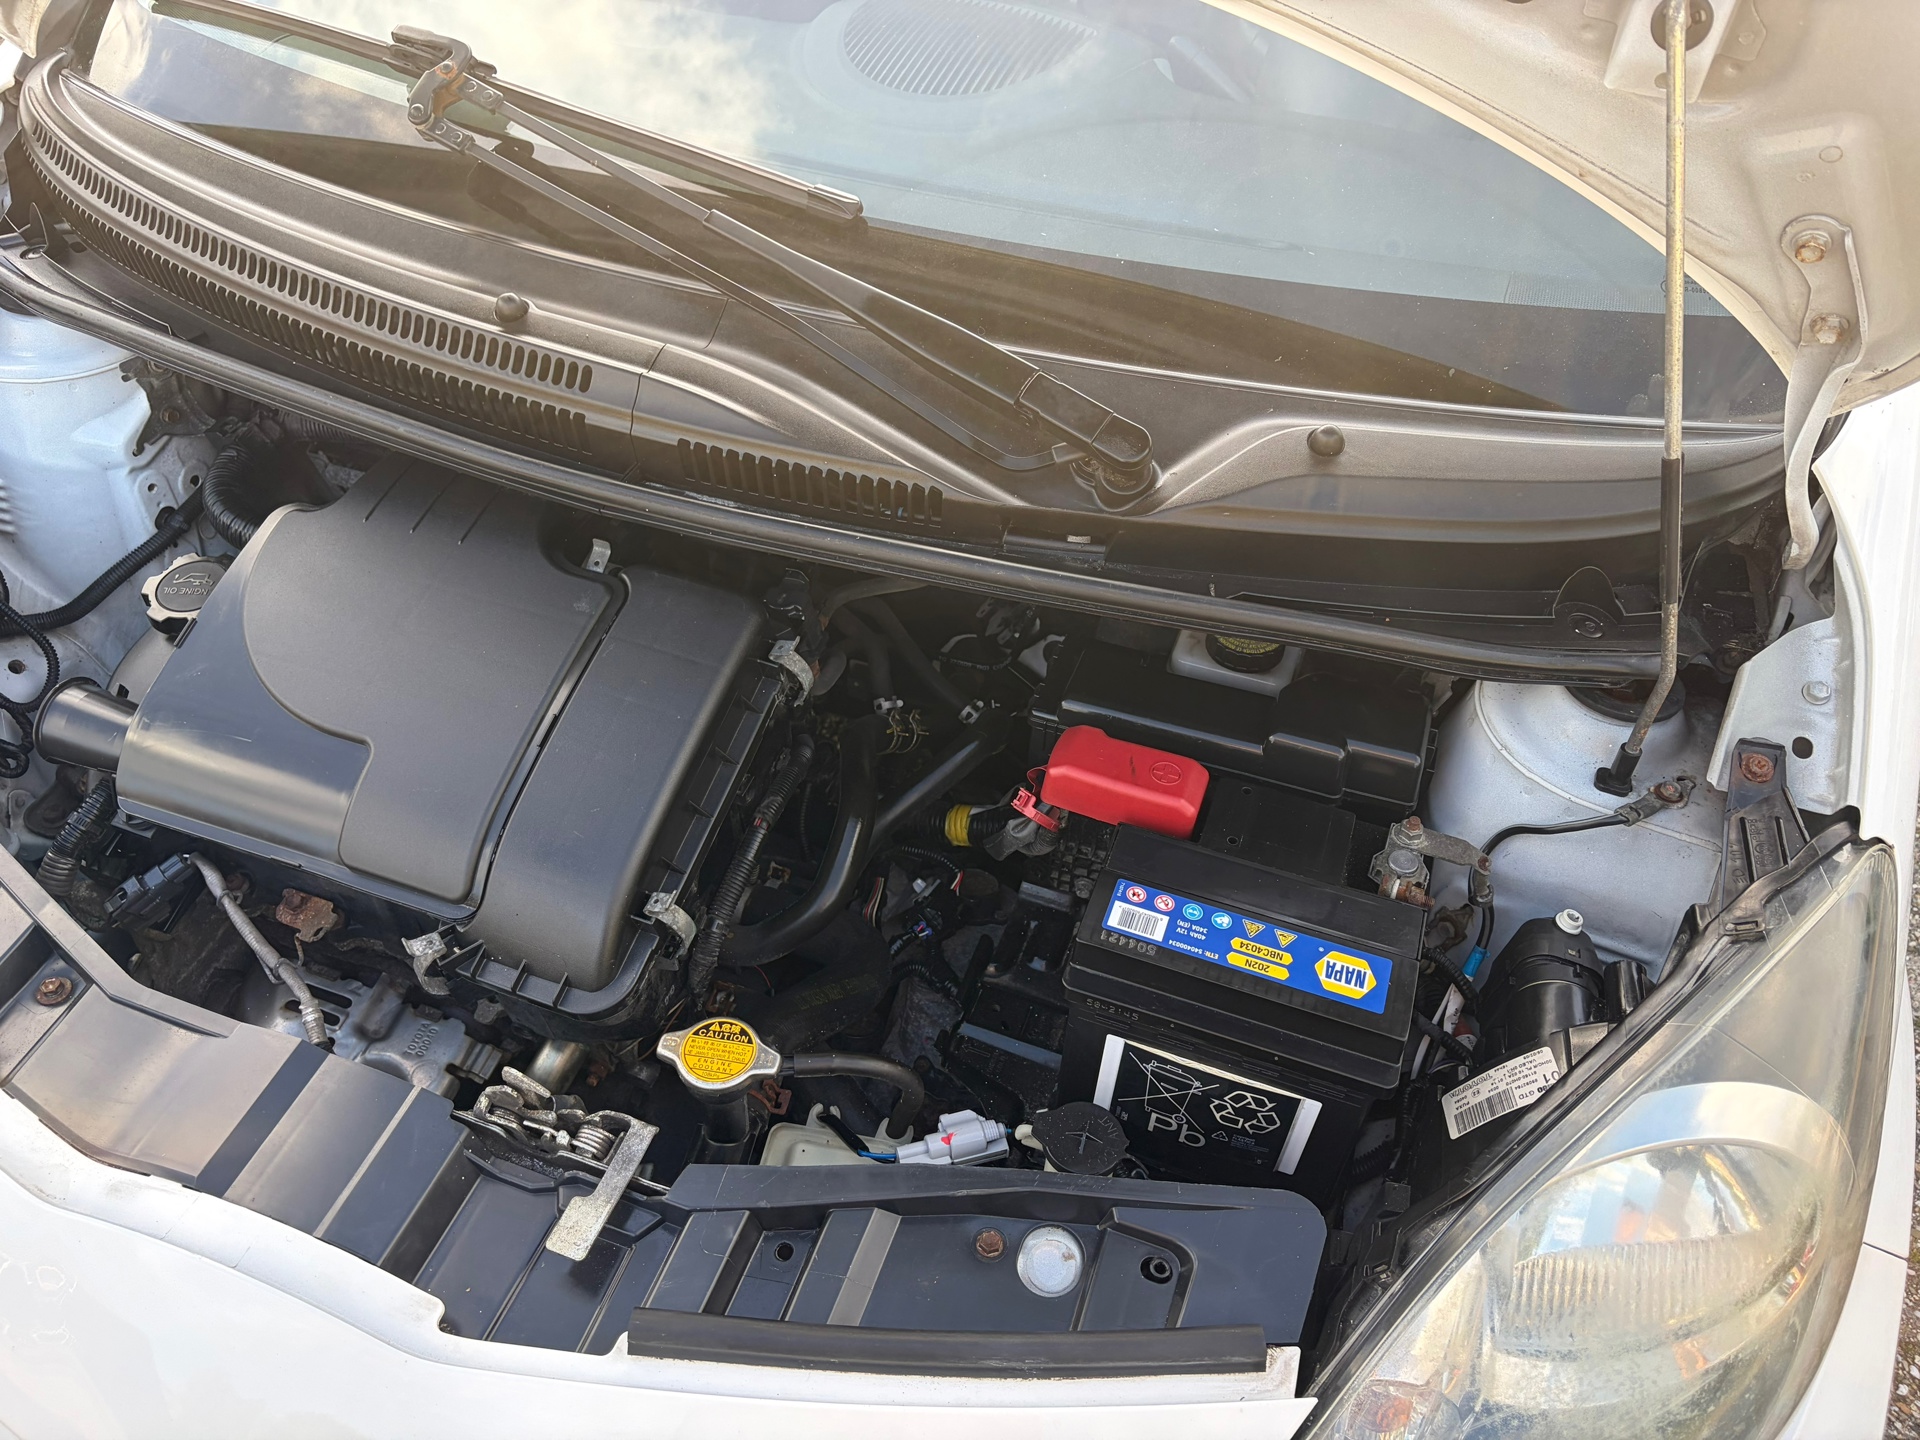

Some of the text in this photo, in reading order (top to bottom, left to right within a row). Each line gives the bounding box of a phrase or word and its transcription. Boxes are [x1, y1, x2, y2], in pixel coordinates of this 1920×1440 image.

[163, 586, 210, 596] NGINE OIL
[1175, 927, 1207, 942] 40Ah 12V
[1191, 924, 1209, 934] 340A
[1238, 940, 1285, 962] NBC4034
[1244, 958, 1271, 974] 202N
[1324, 960, 1369, 990] NAPA
[403, 1022, 431, 1056] TOYOTA
[698, 1028, 750, 1044] CAUTION
[692, 1063, 734, 1074] COOLANT
[697, 1057, 732, 1068] ENGINE
[1449, 1073, 1493, 1098] TOYOTA
[1518, 1090, 1535, 1100] GTD
[1147, 1111, 1206, 1148] Pb
